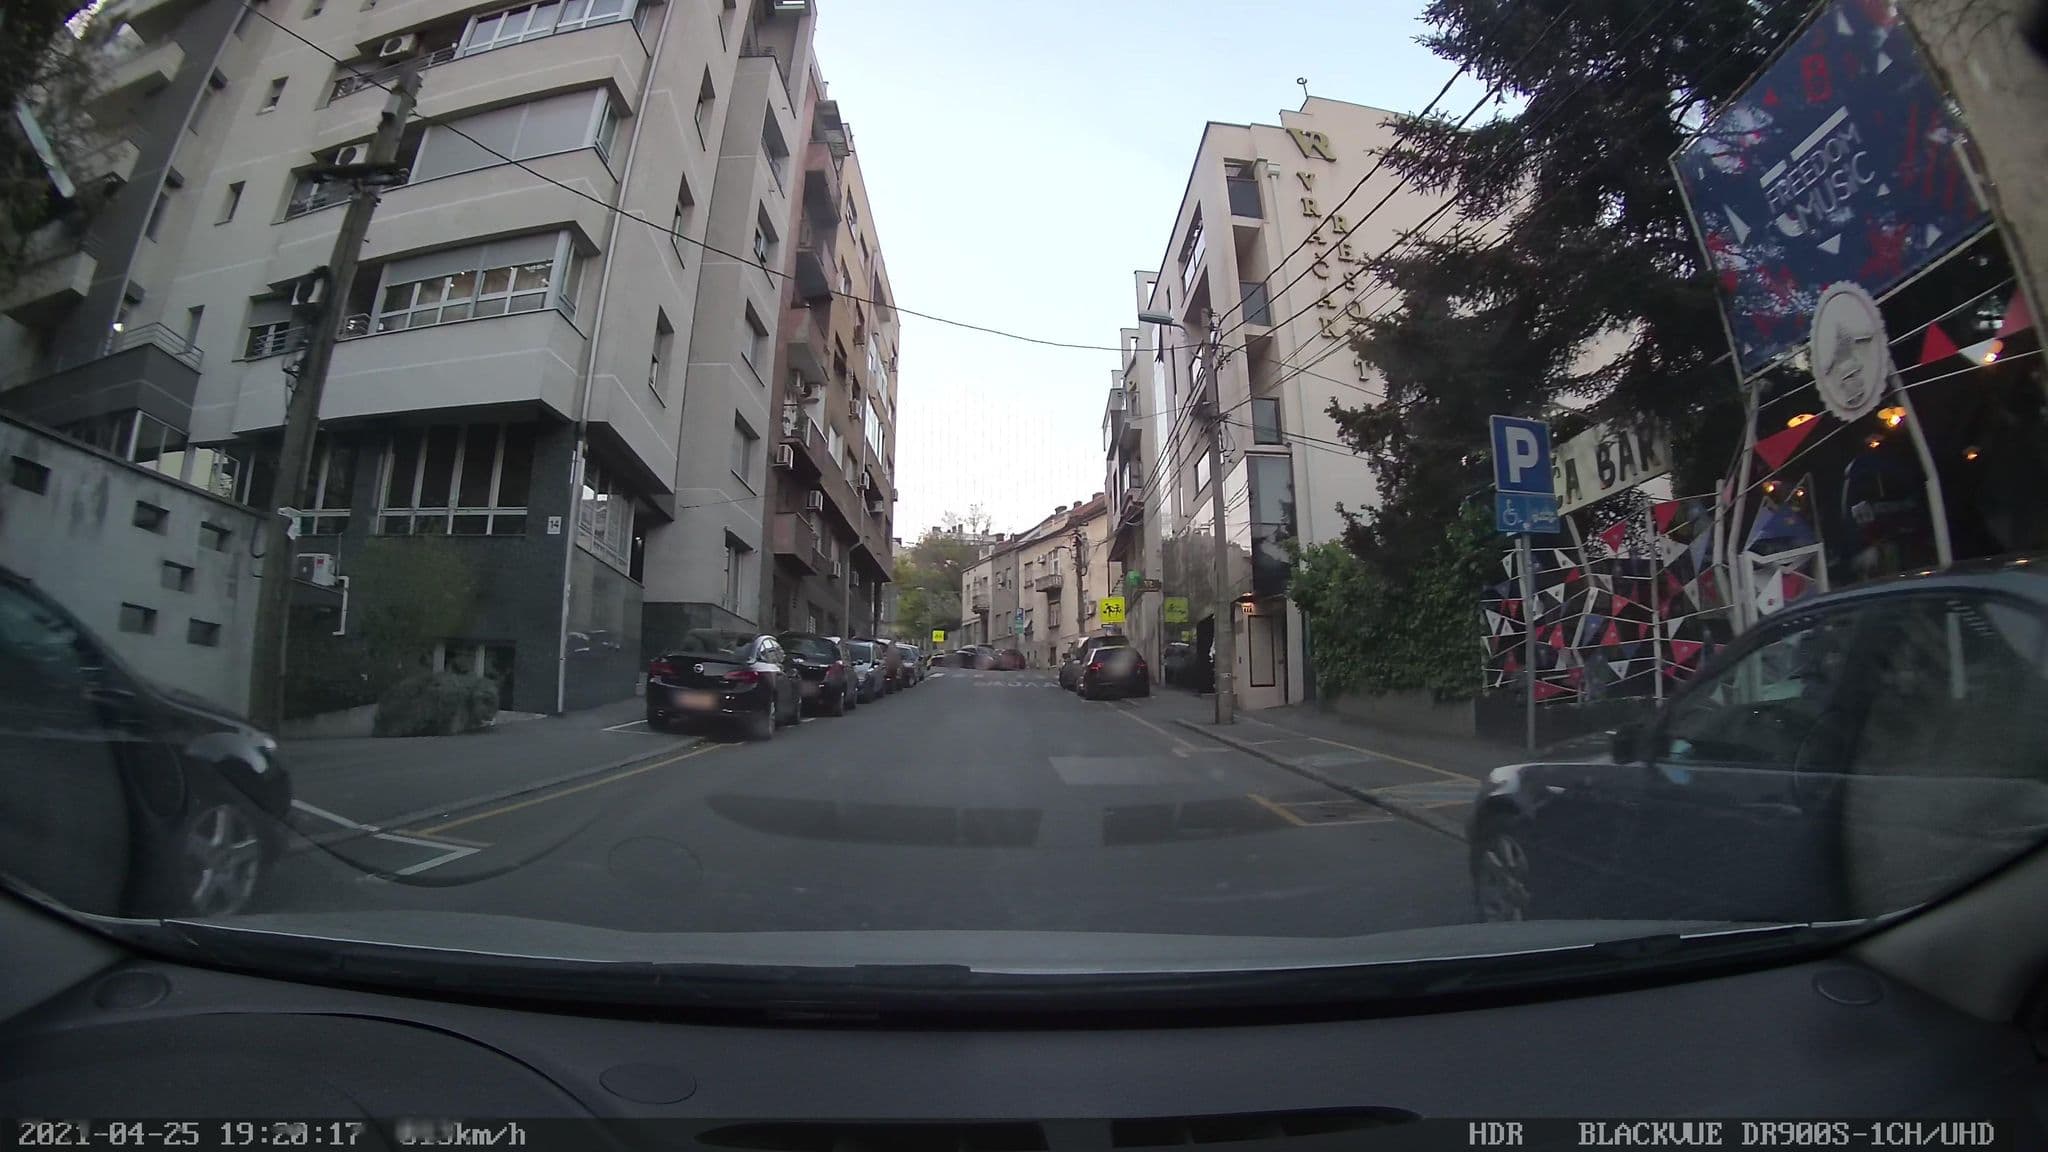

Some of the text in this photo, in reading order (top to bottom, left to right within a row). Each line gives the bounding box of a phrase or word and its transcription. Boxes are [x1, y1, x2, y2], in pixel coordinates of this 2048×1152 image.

[1766, 122, 1862, 214] FREEDOM
[1796, 150, 1876, 233] MUSIC
[1330, 215, 1376, 382] RESOT
[1505, 426, 1539, 483] P
[1596, 420, 1662, 490] BAR
[549, 519, 560, 529] 14
